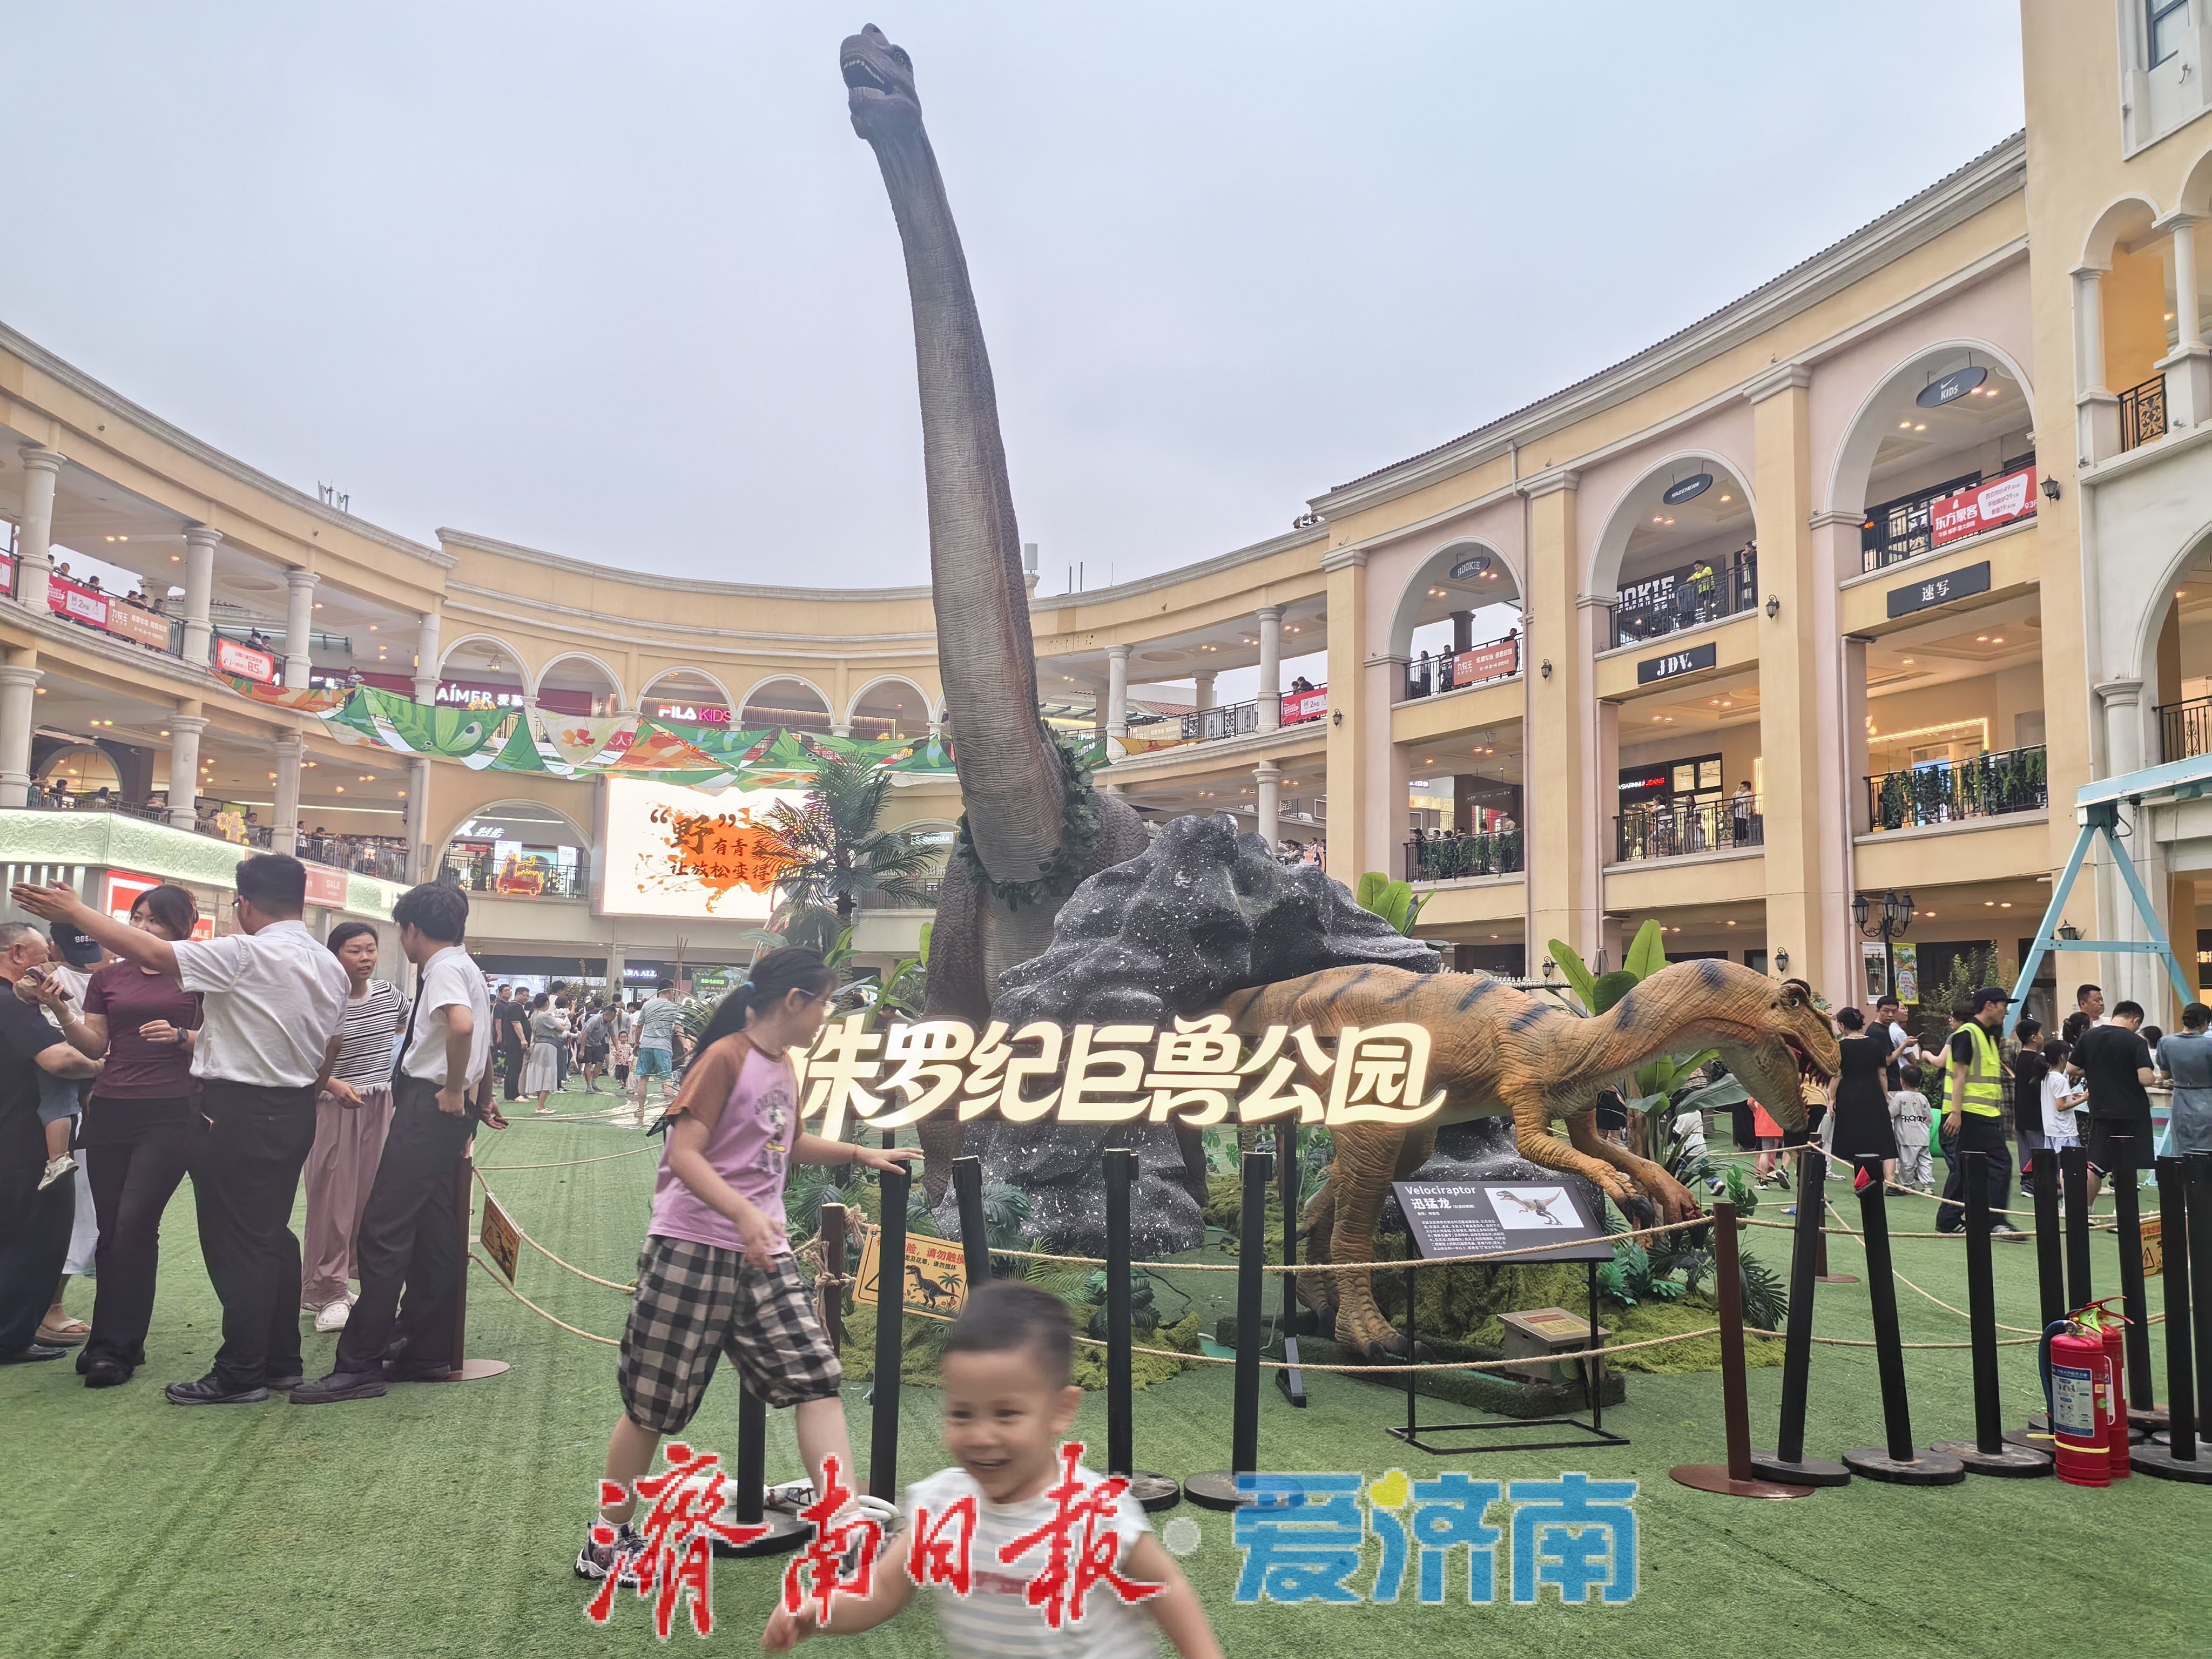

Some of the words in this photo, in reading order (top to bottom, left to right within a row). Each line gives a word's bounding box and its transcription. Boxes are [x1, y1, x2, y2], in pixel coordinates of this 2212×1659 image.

[1940, 385, 1959, 400] KIDS
[1671, 481, 1700, 498] SKECHERS
[1457, 561, 1480, 577] ROOKIE
[1616, 575, 1675, 614] OOKIE
[1922, 579, 1950, 602] 速写
[1657, 653, 1690, 676] JDV
[496, 694, 523, 706] 爱慕
[658, 705, 697, 720] FILA
[699, 707, 733, 723] KIDS
[474, 826, 505, 838] 特步
[75, 935, 93, 943] BOS
[191, 928, 210, 940] ALE
[790, 1013, 1449, 1141] 侏罗纪巨兽公园
[1405, 1185, 1476, 1196] Velociraptor
[1410, 1197, 1452, 1210] 迅猛龙
[905, 1243, 966, 1265] 险，请勿触摸
